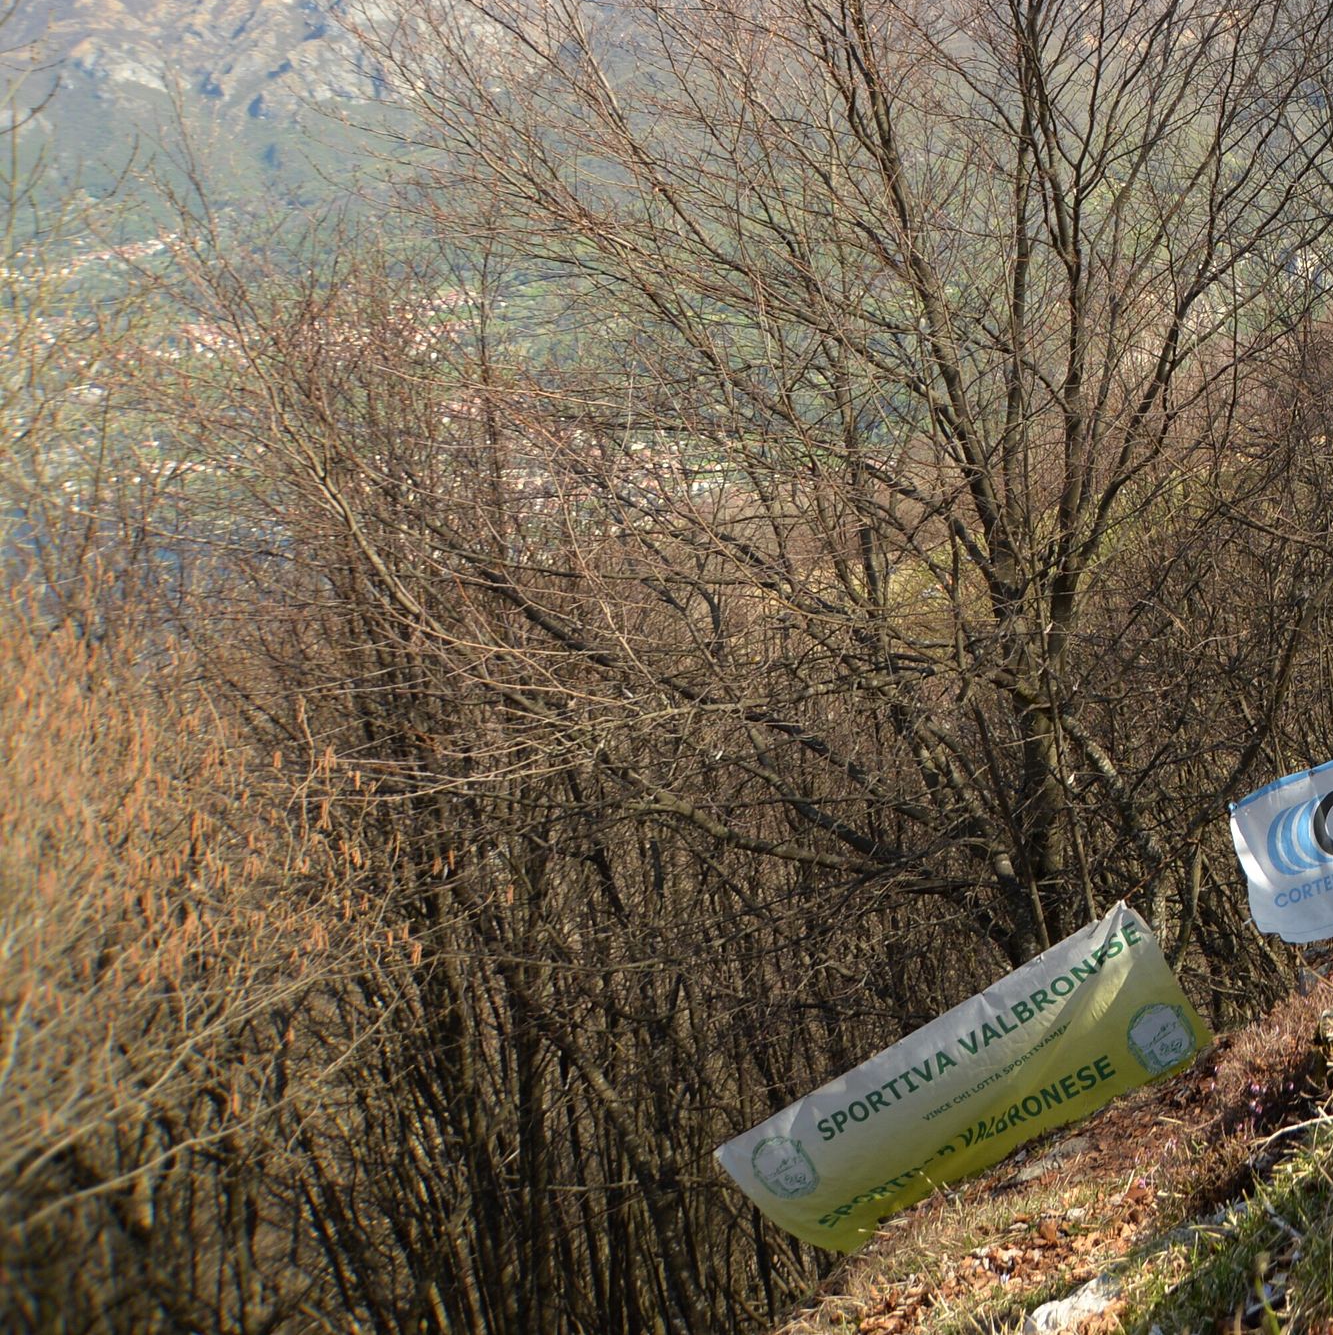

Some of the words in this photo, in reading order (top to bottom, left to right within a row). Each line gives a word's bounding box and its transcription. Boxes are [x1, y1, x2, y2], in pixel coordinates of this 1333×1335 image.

[816, 1051, 958, 1142] SPORTIVA
[957, 920, 1142, 1055] VALBRONESE
[922, 1101, 954, 1122] VINCE
[953, 1090, 971, 1105] CHI
[972, 1072, 1002, 1095] LOTTA
